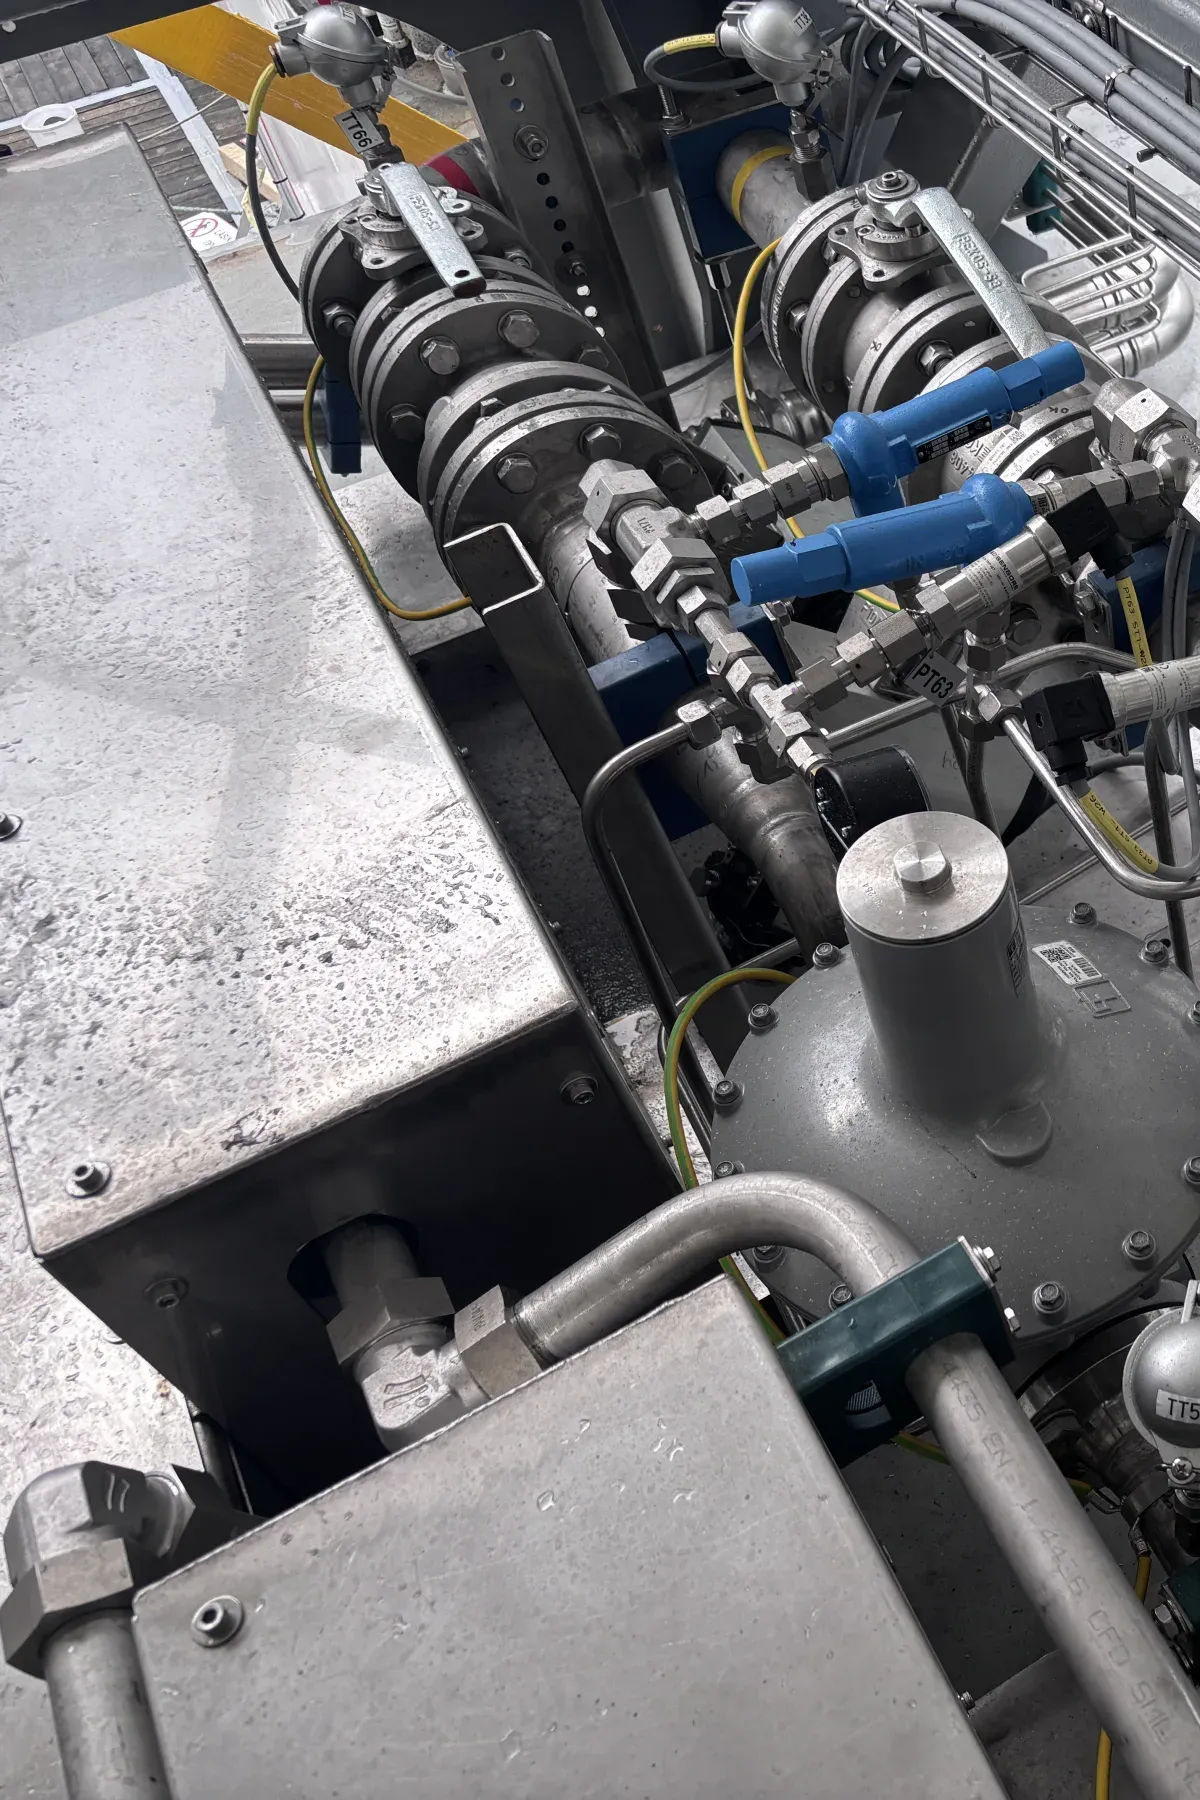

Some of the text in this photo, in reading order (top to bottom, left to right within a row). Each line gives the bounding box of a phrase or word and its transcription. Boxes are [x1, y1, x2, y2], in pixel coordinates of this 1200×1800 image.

[341, 112, 372, 148] TT66
[1123, 586, 1148, 668] PT63 ST1-W2
[912, 663, 953, 698] PT63
[1134, 844, 1153, 865] PT33
